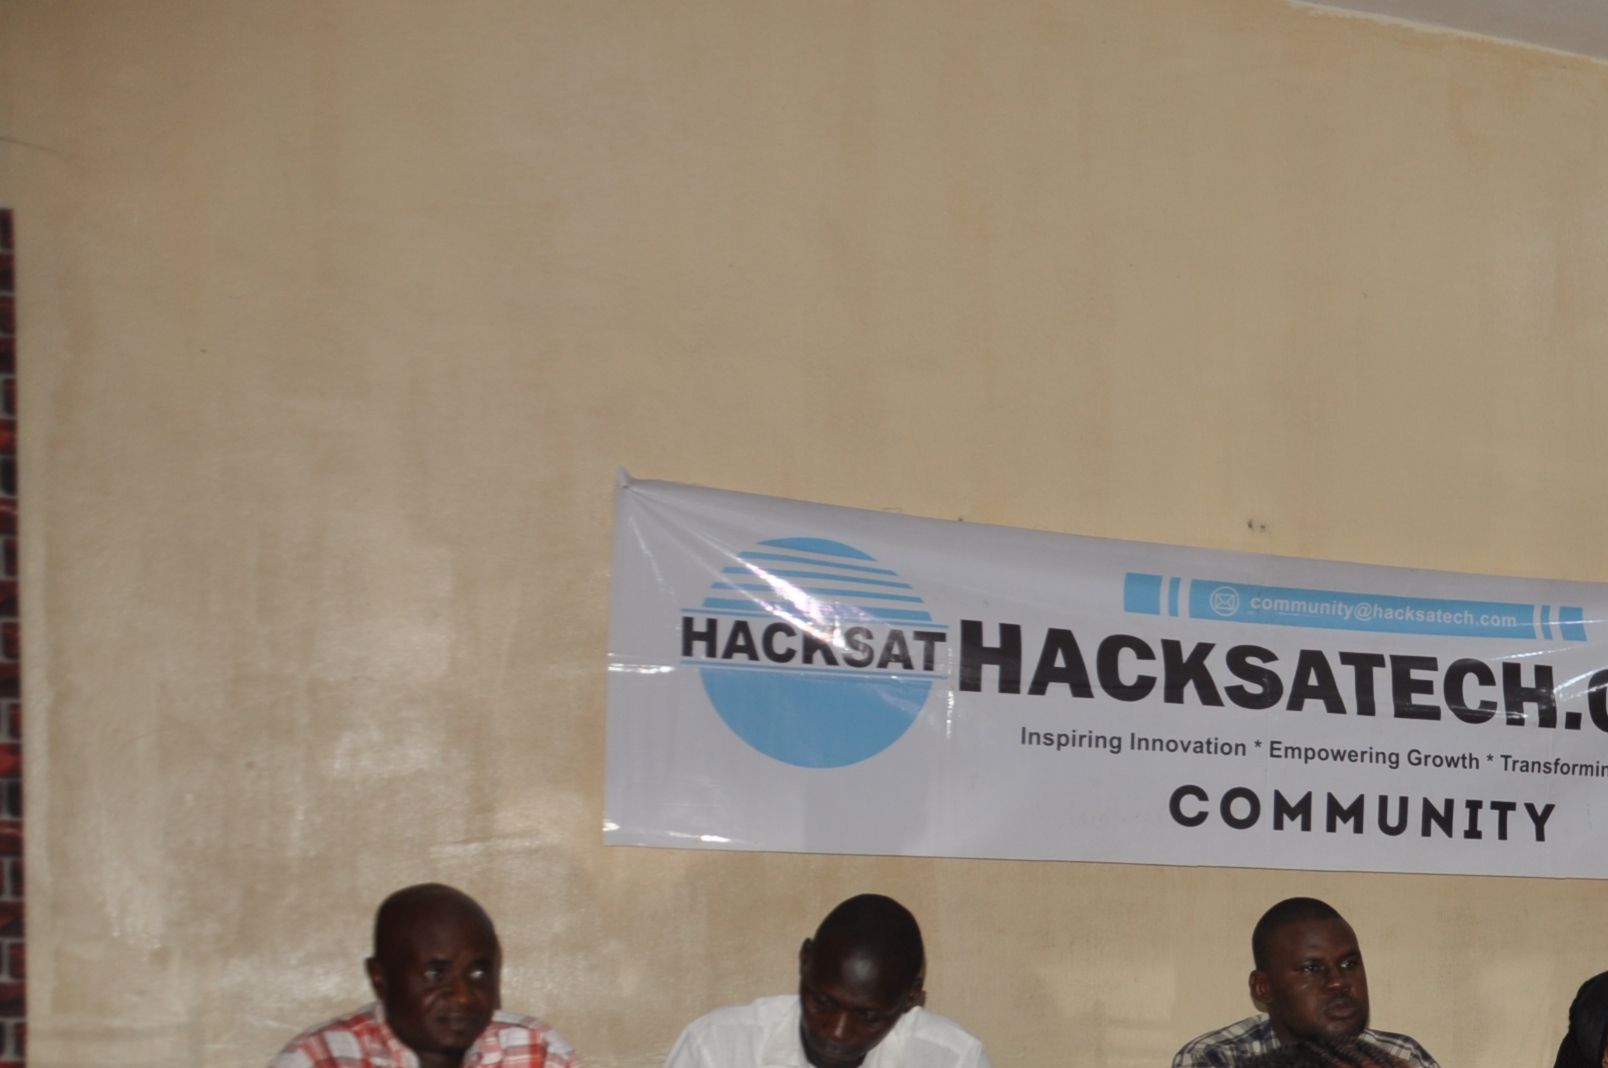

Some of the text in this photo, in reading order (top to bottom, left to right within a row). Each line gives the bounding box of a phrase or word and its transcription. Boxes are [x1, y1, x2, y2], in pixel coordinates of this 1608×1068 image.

[1250, 593, 1517, 629] community@hacksatech.com
[681, 616, 947, 671] HACKSAT
[1020, 726, 1123, 754] Inspiring
[1129, 731, 1247, 757] Innovation
[1269, 740, 1401, 770] Empowering
[1406, 748, 1481, 771] Growth
[1169, 784, 1557, 843] COMMUNITY
